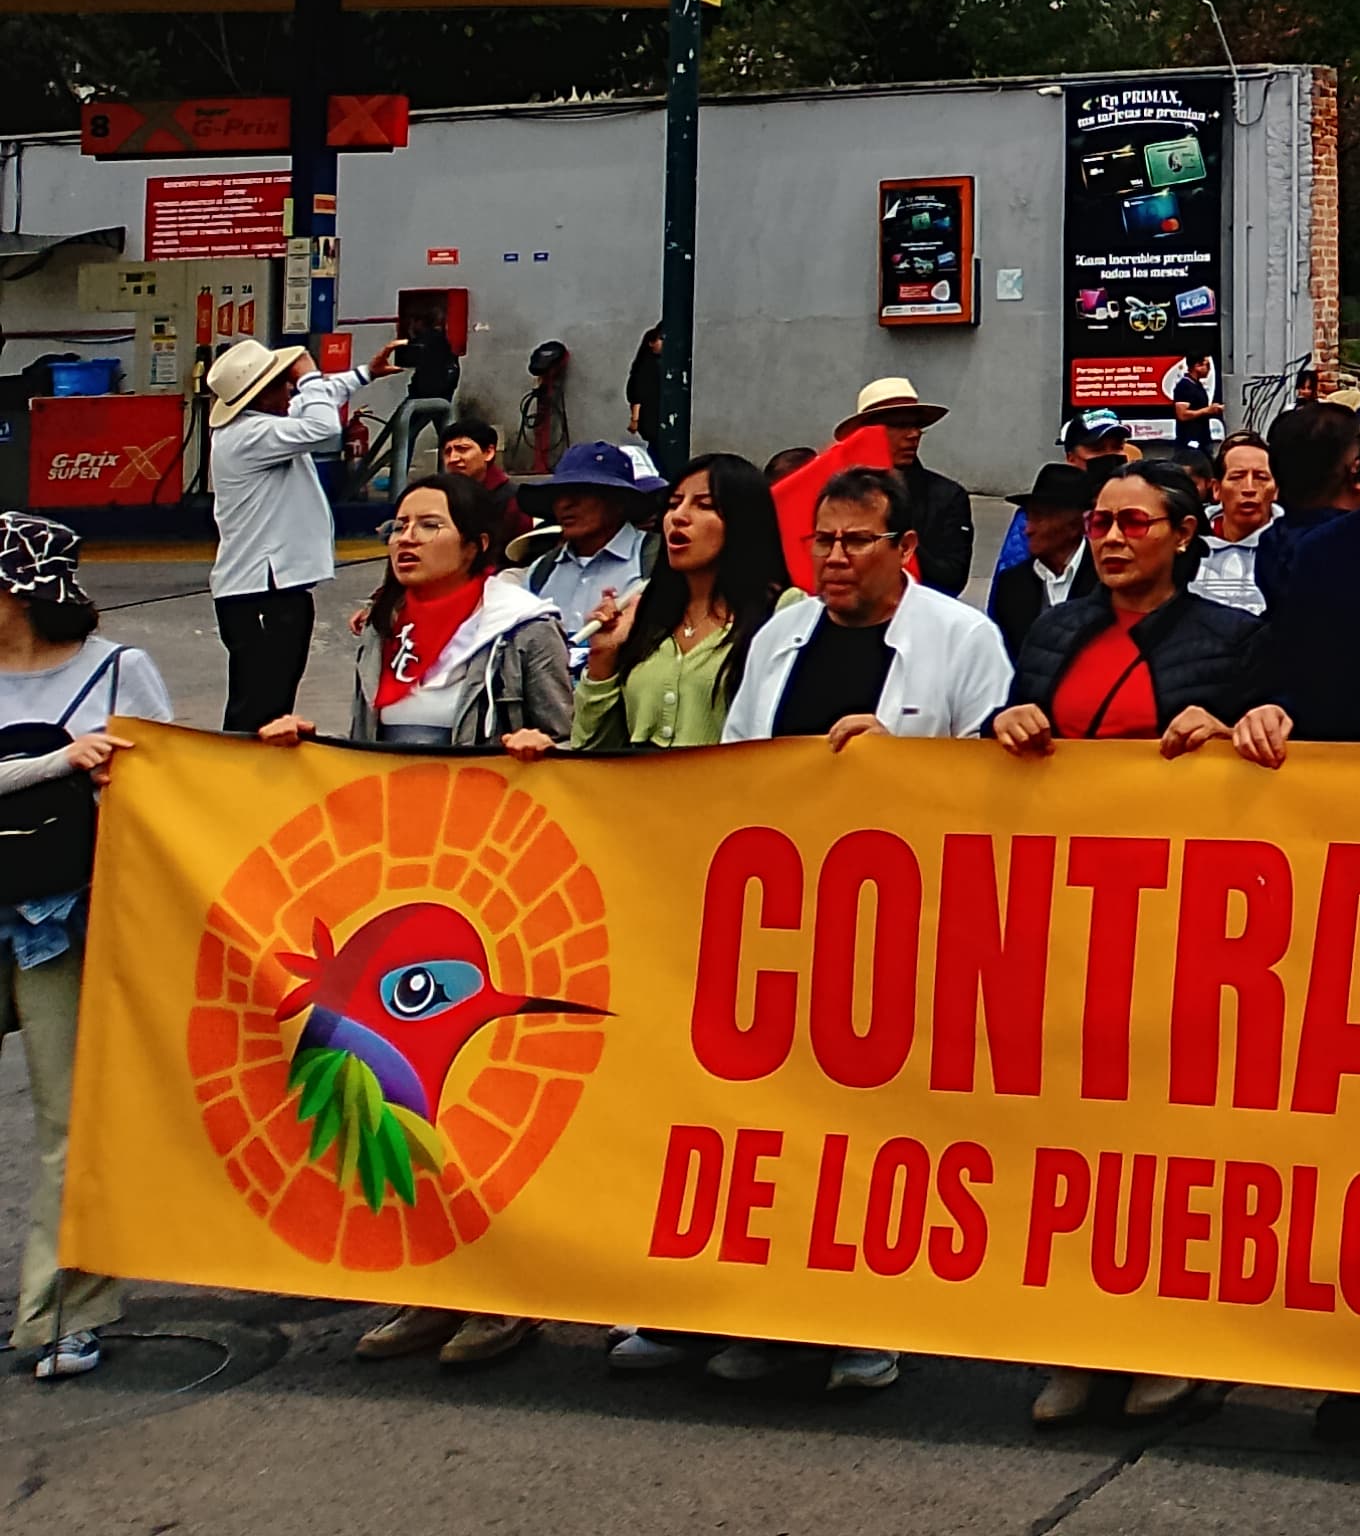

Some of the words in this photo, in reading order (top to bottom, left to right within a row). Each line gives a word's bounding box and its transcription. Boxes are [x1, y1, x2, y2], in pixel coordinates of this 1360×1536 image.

[90, 115, 109, 138] 8
[192, 117, 279, 138] G-Prix
[51, 451, 120, 468] G-Prix
[48, 467, 101, 480] SUPER
[648, 1124, 785, 1265] DE
[806, 1132, 994, 1283] LOS
